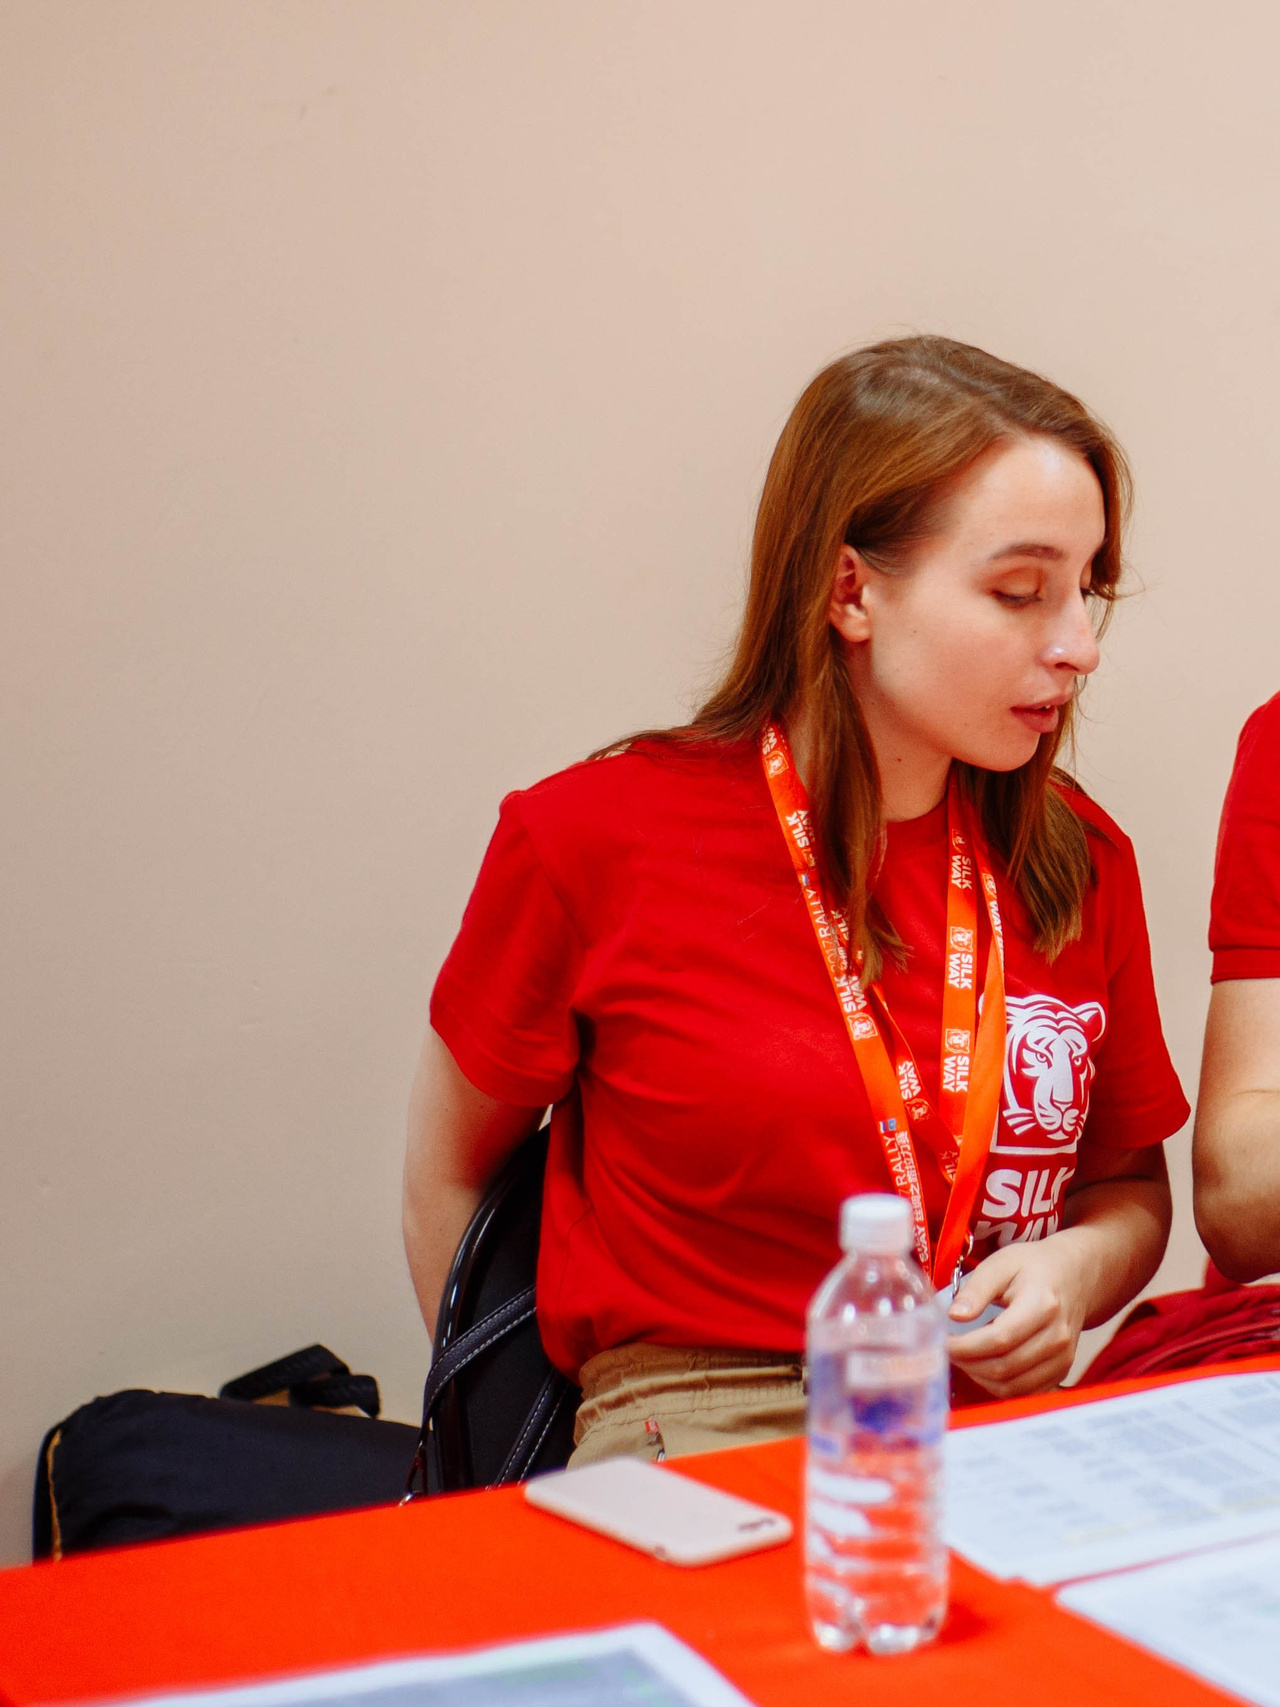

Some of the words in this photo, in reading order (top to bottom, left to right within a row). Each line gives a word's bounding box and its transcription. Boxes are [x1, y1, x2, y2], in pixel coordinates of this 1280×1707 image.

[785, 811, 810, 848] SILK
[950, 854, 962, 889] WAY
[961, 855, 972, 890] SILK
[806, 888, 831, 938] RALLY
[948, 952, 961, 990] WAY
[959, 952, 973, 990] SILK
[834, 974, 857, 1013] SILK
[898, 1063, 912, 1100] SILK
[905, 1060, 921, 1096] WAY
[943, 1055, 956, 1092] WAY
[956, 1055, 970, 1092] SILK
[883, 1135, 908, 1186] RALLY
[981, 1166, 1076, 1218] SILK
